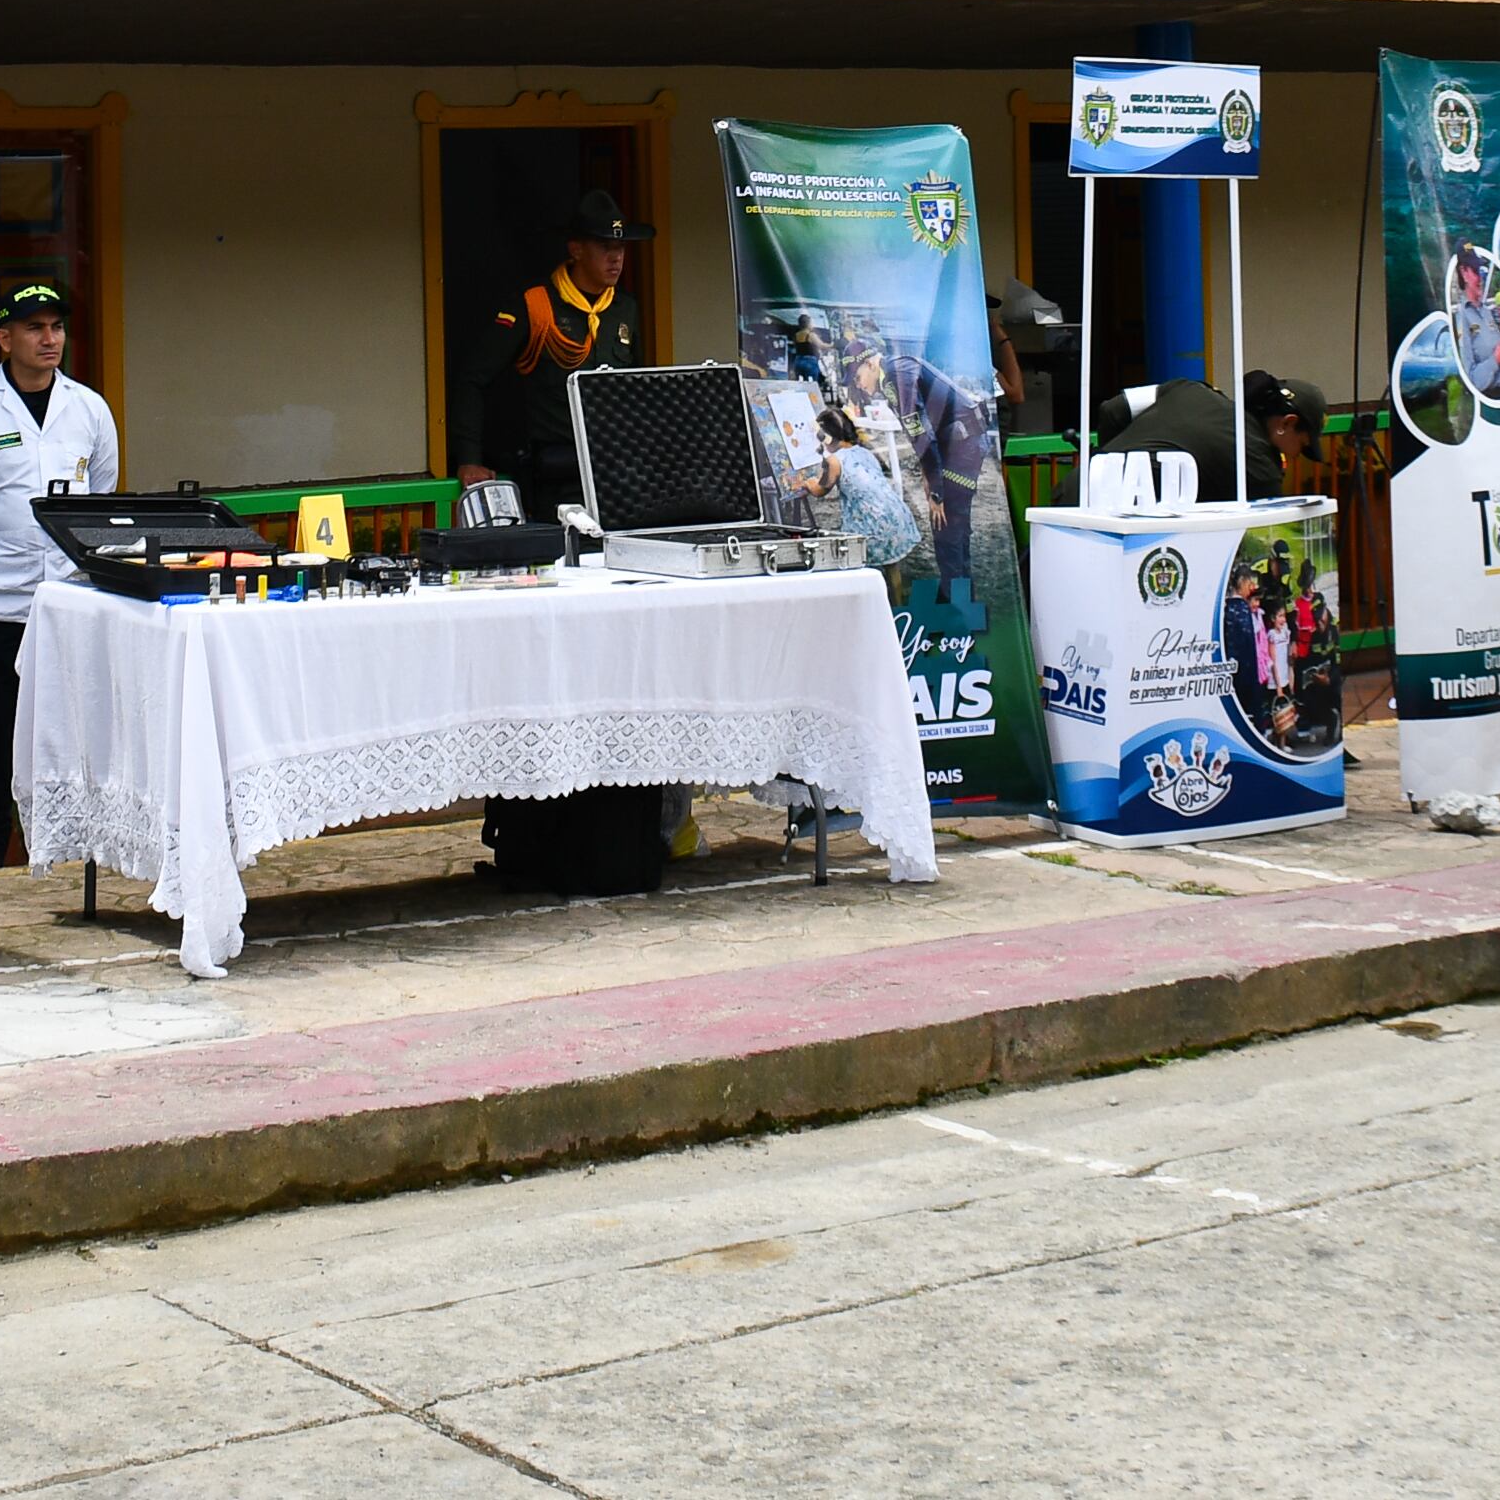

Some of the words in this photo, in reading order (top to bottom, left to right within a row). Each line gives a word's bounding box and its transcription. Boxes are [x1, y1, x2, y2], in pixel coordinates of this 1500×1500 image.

[749, 171, 786, 186] GRUPO
[787, 175, 804, 186] DE
[804, 174, 875, 189] PROTECCIÓN
[877, 177, 887, 188] A
[735, 186, 754, 197] LA
[755, 185, 805, 200] INFANCIA
[805, 189, 816, 201] Y
[816, 190, 902, 203] ADOLESCENCIA
[745, 205, 763, 214] DEL
[763, 206, 821, 217] DEPARTAMENTO
[821, 210, 833, 218] DE
[315, 516, 335, 547] 4
[893, 610, 935, 671] Yo
[938, 634, 975, 664] soy
[1146, 627, 1220, 665] Proteger
[1060, 645, 1084, 679] Yo
[1130, 666, 1141, 682] la
[1142, 666, 1170, 681] niñez
[1177, 664, 1186, 678] la
[1186, 660, 1238, 677] adolescencia
[1129, 688, 1140, 700] es
[1141, 685, 1178, 701] proteger
[1429, 673, 1497, 701] Turismo
[926, 767, 964, 786] PAIS
[1180, 776, 1204, 787] Abre
